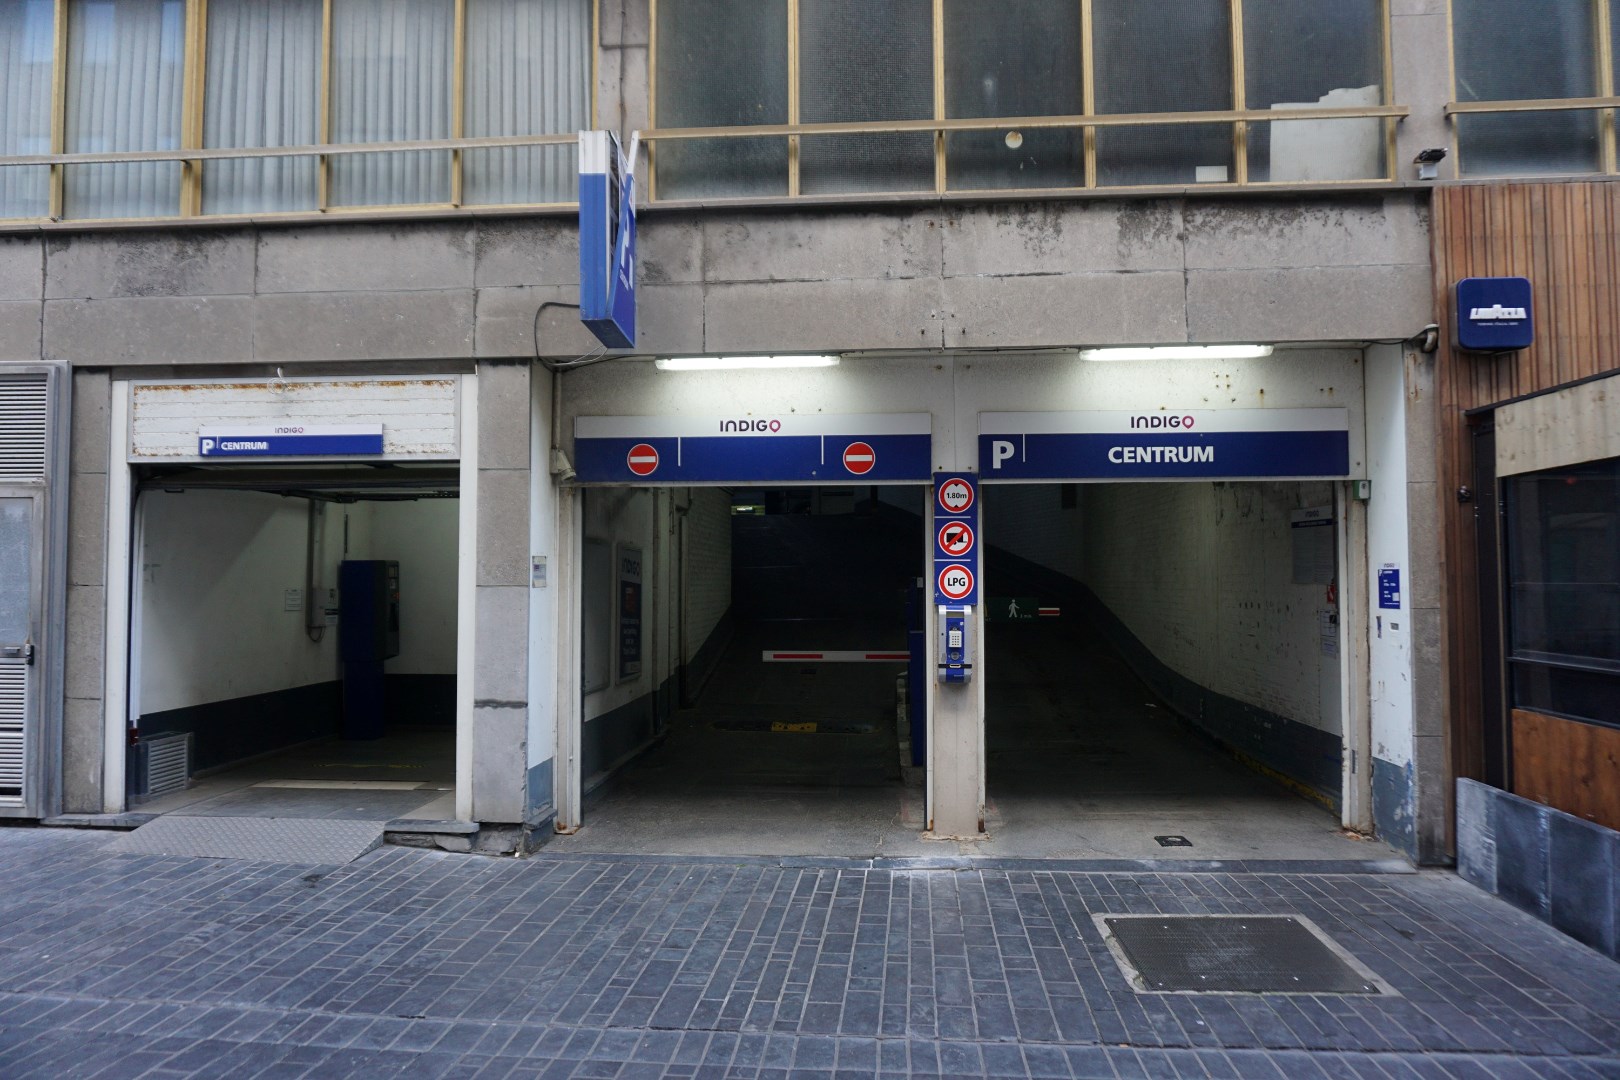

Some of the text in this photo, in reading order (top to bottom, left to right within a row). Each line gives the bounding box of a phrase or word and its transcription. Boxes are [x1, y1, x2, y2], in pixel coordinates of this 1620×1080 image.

[720, 419, 781, 433] INDIGO
[1130, 415, 1194, 429] INDIGO
[274, 426, 304, 434] INDIGO
[202, 439, 269, 455] P CENTRUM
[992, 440, 1214, 469] P CENTRUM
[947, 577, 966, 587] LPG
